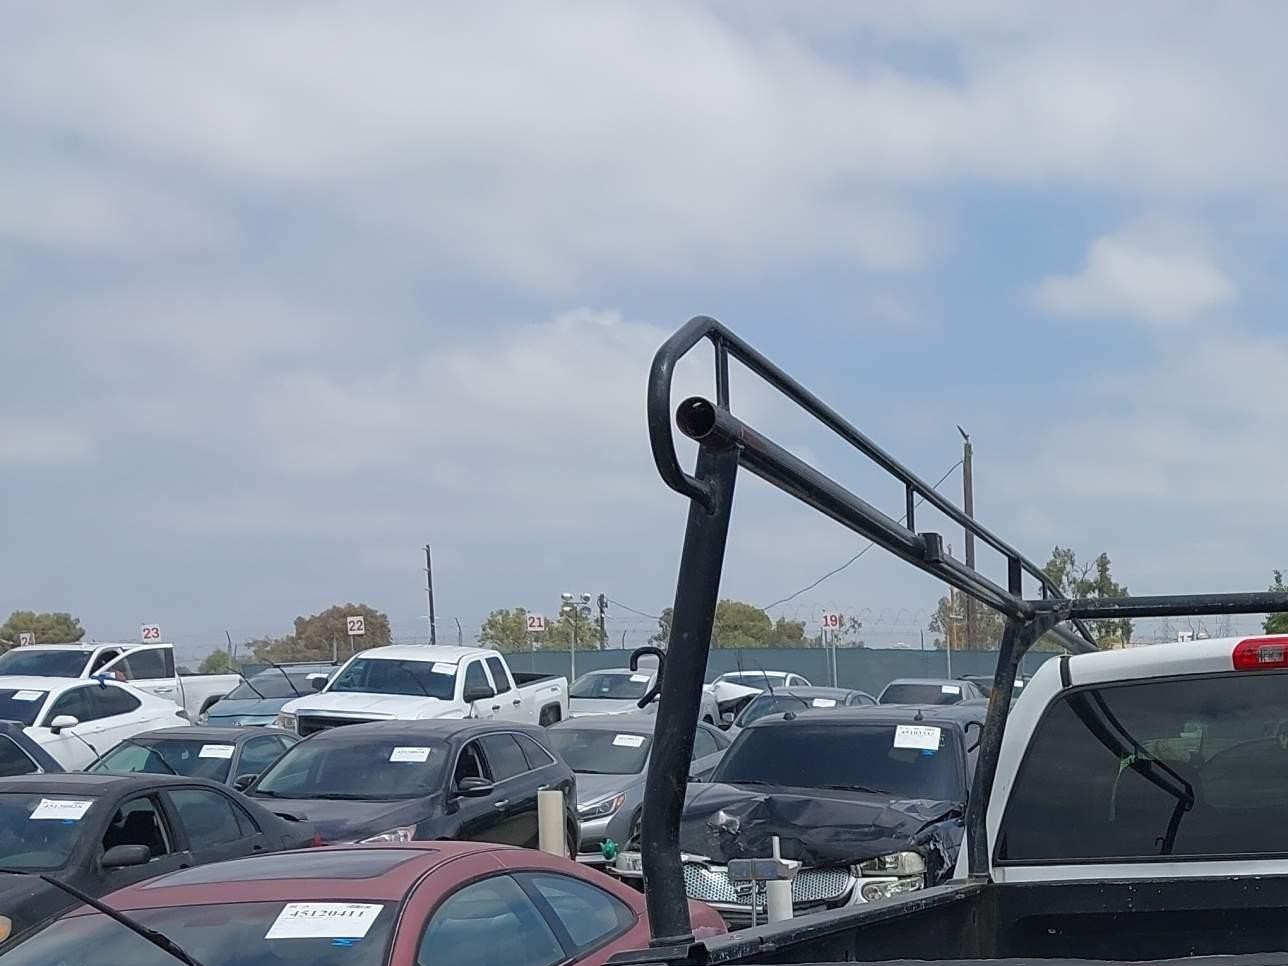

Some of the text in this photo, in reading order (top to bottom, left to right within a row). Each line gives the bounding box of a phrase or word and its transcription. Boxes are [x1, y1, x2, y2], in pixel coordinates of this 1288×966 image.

[349, 620, 363, 631] 22
[528, 616, 543, 628] 21
[823, 614, 838, 627] 19
[143, 627, 160, 639] 23
